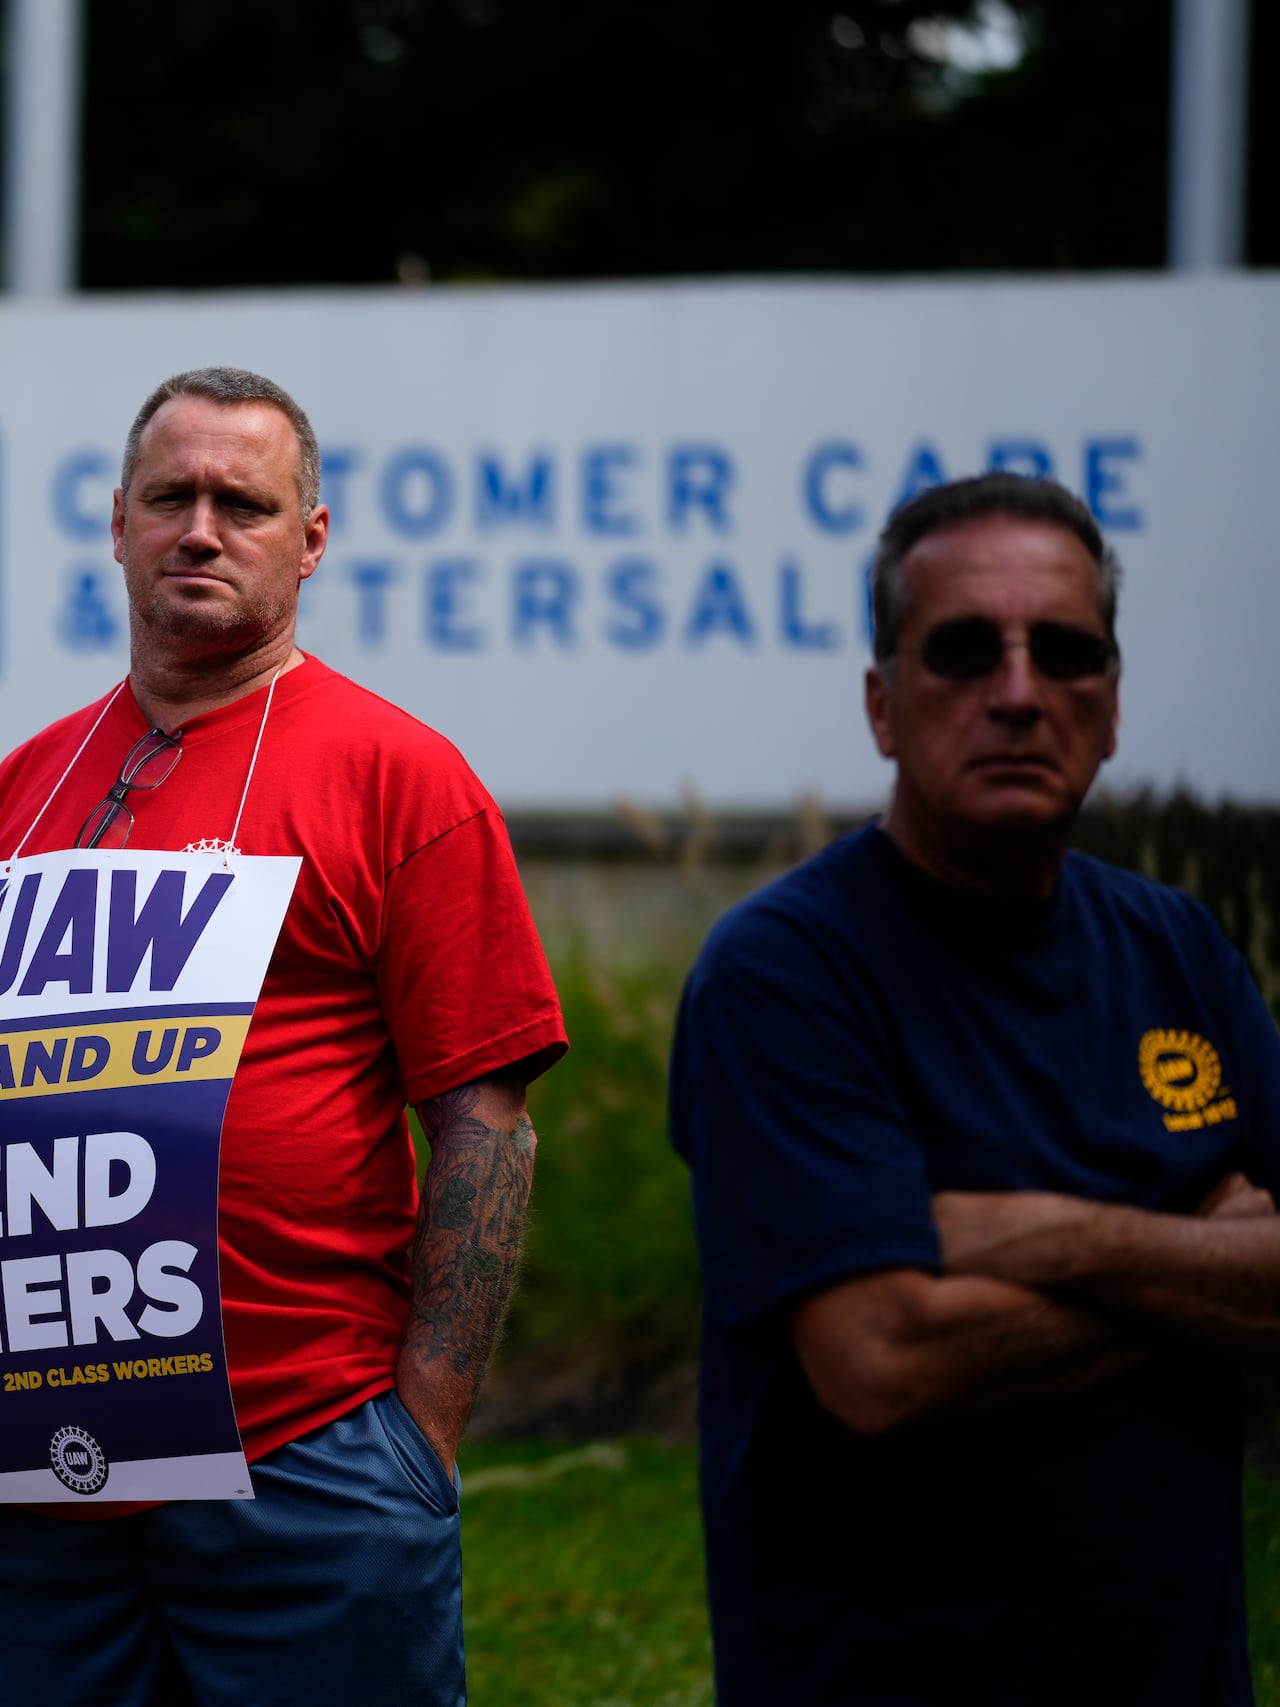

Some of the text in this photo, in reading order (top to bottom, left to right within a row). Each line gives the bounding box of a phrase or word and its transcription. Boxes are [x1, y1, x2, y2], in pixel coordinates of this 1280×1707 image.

[50, 440, 740, 545] CTOMER
[56, 553, 877, 657] & TERSAL
[131, 1026, 222, 1076] UP
[3, 1370, 43, 1392] 2ND
[47, 1363, 110, 1388] CLASS
[113, 1353, 214, 1381] WORKERS
[65, 1451, 89, 1466] UAW
